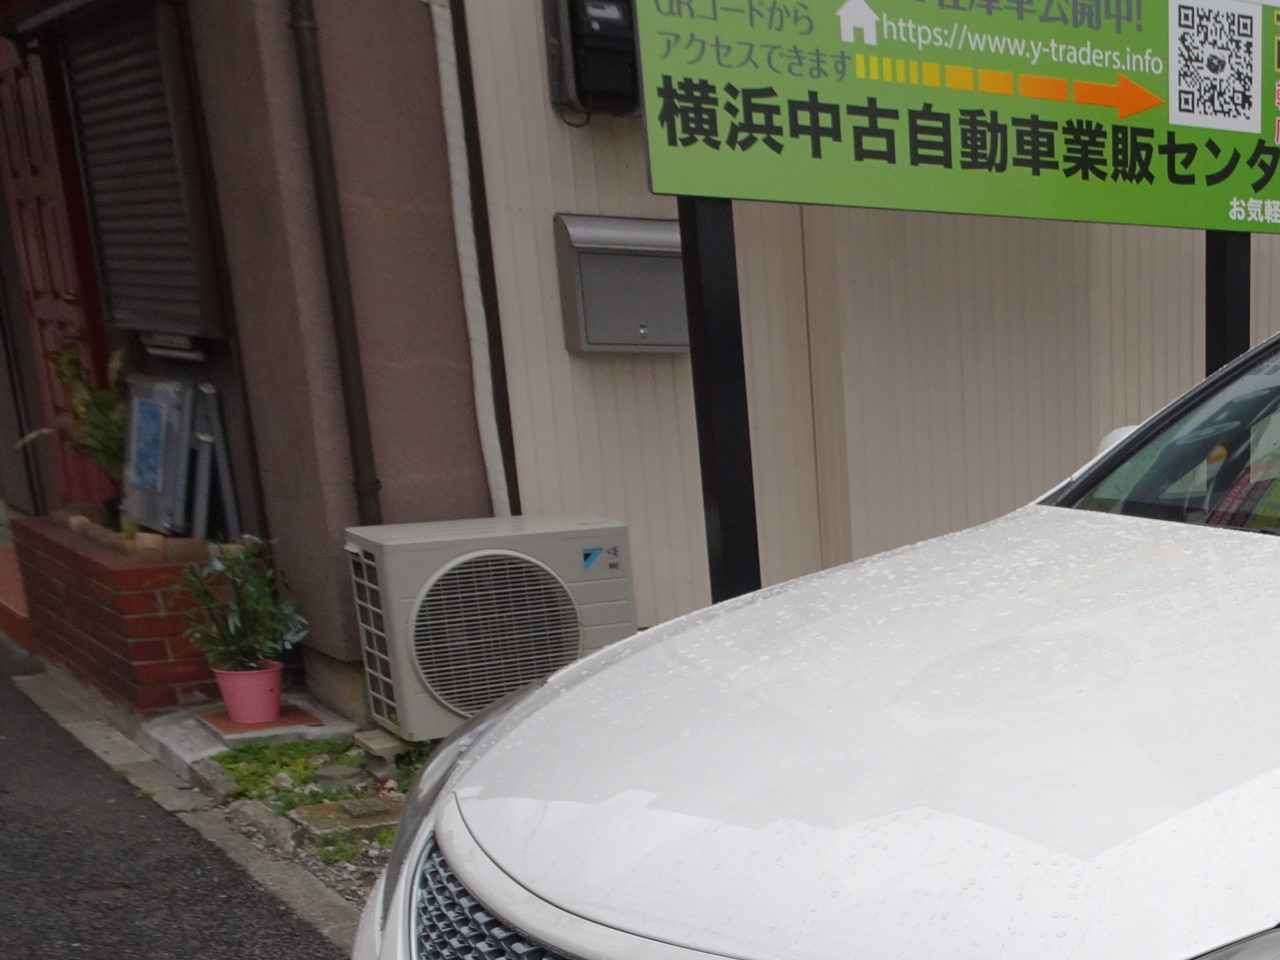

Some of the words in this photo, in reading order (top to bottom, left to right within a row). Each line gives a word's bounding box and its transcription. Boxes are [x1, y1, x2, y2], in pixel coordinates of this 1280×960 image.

[656, 31, 852, 82] アクセスできます
[882, 11, 1164, 75] https://www.y-traders.info
